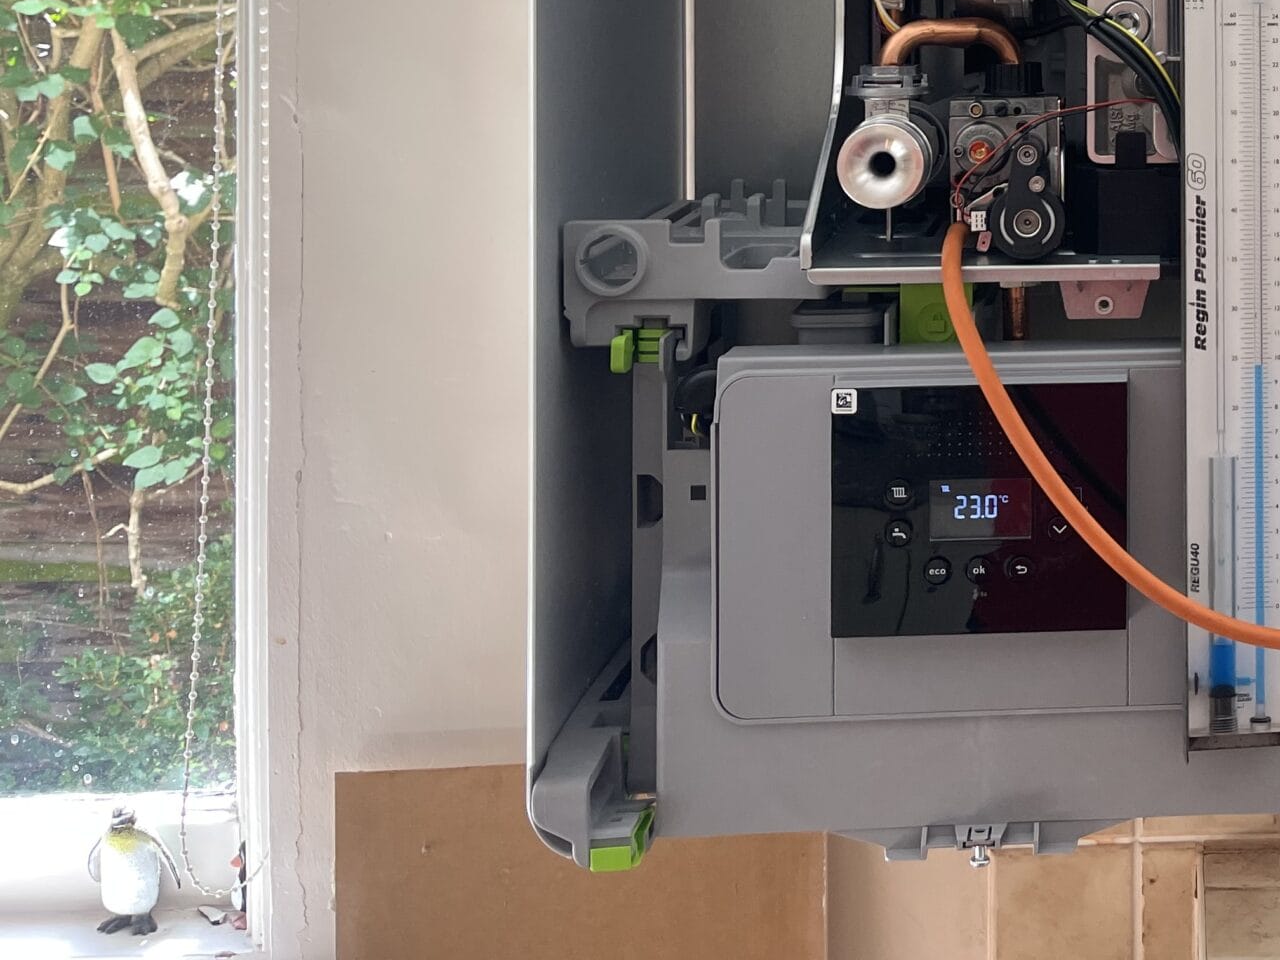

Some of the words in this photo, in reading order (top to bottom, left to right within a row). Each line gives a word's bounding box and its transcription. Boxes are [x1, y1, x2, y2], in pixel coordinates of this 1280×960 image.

[1186, 152, 1207, 190] 60
[1188, 195, 1206, 284] Premier
[1187, 290, 1207, 352] Regin
[928, 567, 946, 576] eco
[972, 565, 986, 575] ok
[1189, 542, 1200, 593] REGU40
